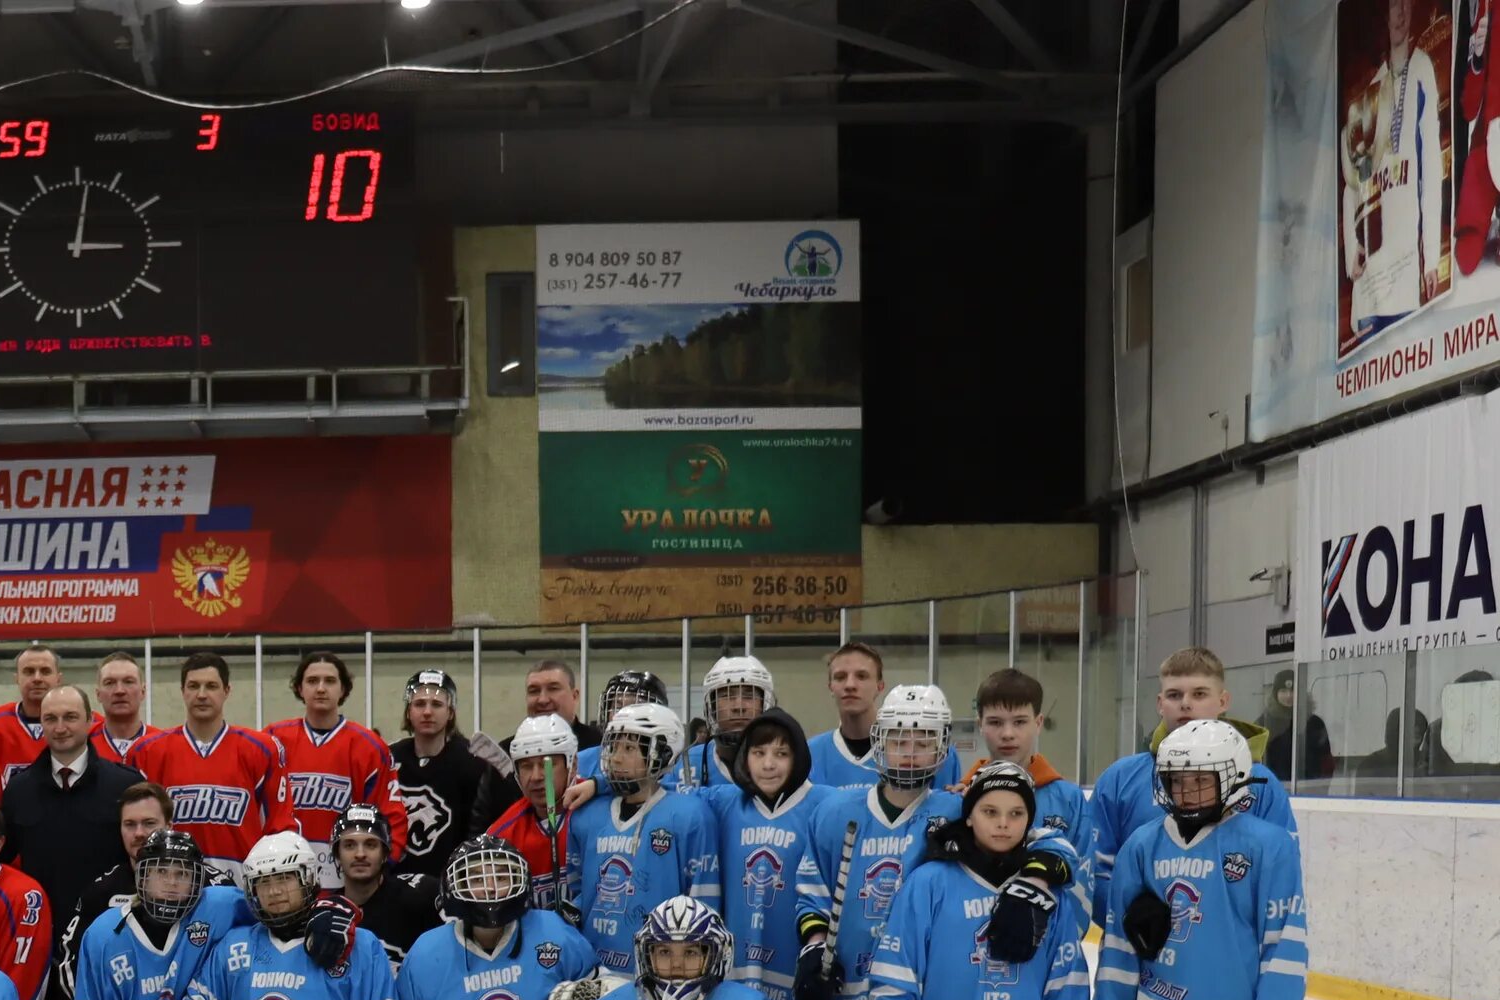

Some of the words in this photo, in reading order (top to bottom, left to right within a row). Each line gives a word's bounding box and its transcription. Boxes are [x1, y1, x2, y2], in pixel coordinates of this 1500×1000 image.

[196, 113, 221, 151] 3
[311, 111, 381, 132] БОВИД
[304, 148, 382, 222] 10
[550, 253, 558, 267] 8
[565, 252, 595, 267] 904
[600, 252, 630, 266] 809
[636, 251, 656, 266] 50
[662, 251, 682, 265] 87
[547, 278, 578, 292] (351)
[583, 271, 682, 289] 257-46-77
[734, 282, 837, 301] Чебаркуль
[1336, 337, 1434, 399] ЧЕМПИОНЫ
[1443, 312, 1499, 361] МИРА
[643, 414, 754, 427] www.bazasport.ru
[742, 437, 853, 448] www.uralochka74.ru
[620, 508, 773, 531] УРАЛОЧКА
[651, 538, 744, 550] ГОСТИНИЦА
[47, 578, 139, 599] ПРОГРАММА
[752, 574, 847, 596] 256-36-50
[22, 604, 116, 624] ХОККЕИСТОВ
[905, 691, 917, 701] 5
[740, 826, 796, 849] ЮНИОР
[1153, 856, 1215, 880] ЮНИОР
[1223, 862, 1246, 874] АХЛ
[1006, 883, 1055, 911] CM
[13, 936, 33, 964] 11
[251, 970, 306, 990] ЮНИОР
[462, 964, 523, 993] ЮНИОР
